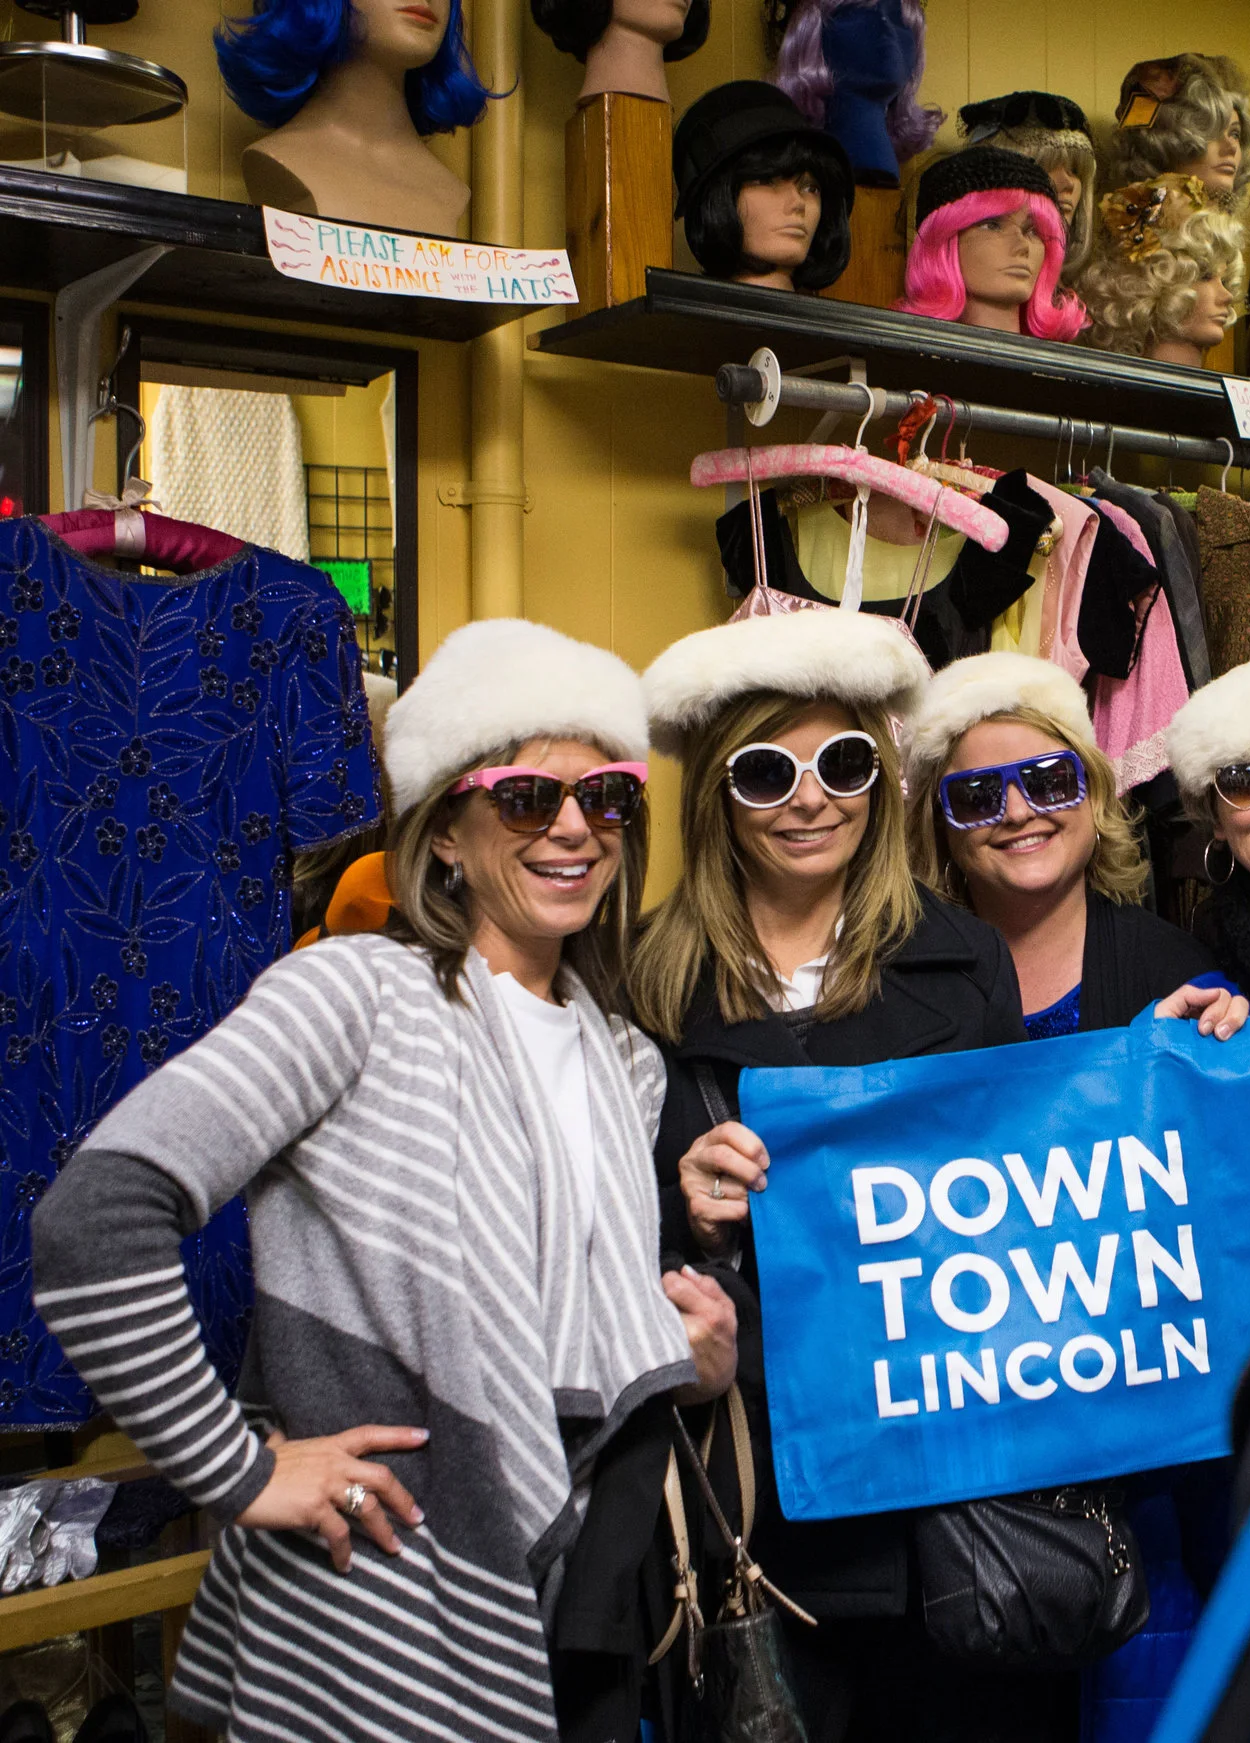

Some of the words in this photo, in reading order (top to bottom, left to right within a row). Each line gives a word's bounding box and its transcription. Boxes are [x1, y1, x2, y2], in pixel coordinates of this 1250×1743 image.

[318, 225, 404, 263] PLEASE
[413, 241, 454, 268] ASK
[464, 248, 511, 271] FOR
[320, 255, 443, 293] ASSISTANCE
[450, 273, 477, 282] WITH
[455, 285, 479, 294] THE
[487, 276, 555, 300] HATS
[852, 1130, 1188, 1244] DOWN
[858, 1224, 1202, 1340] TOWN
[874, 1318, 1210, 1418] LINCOLN
